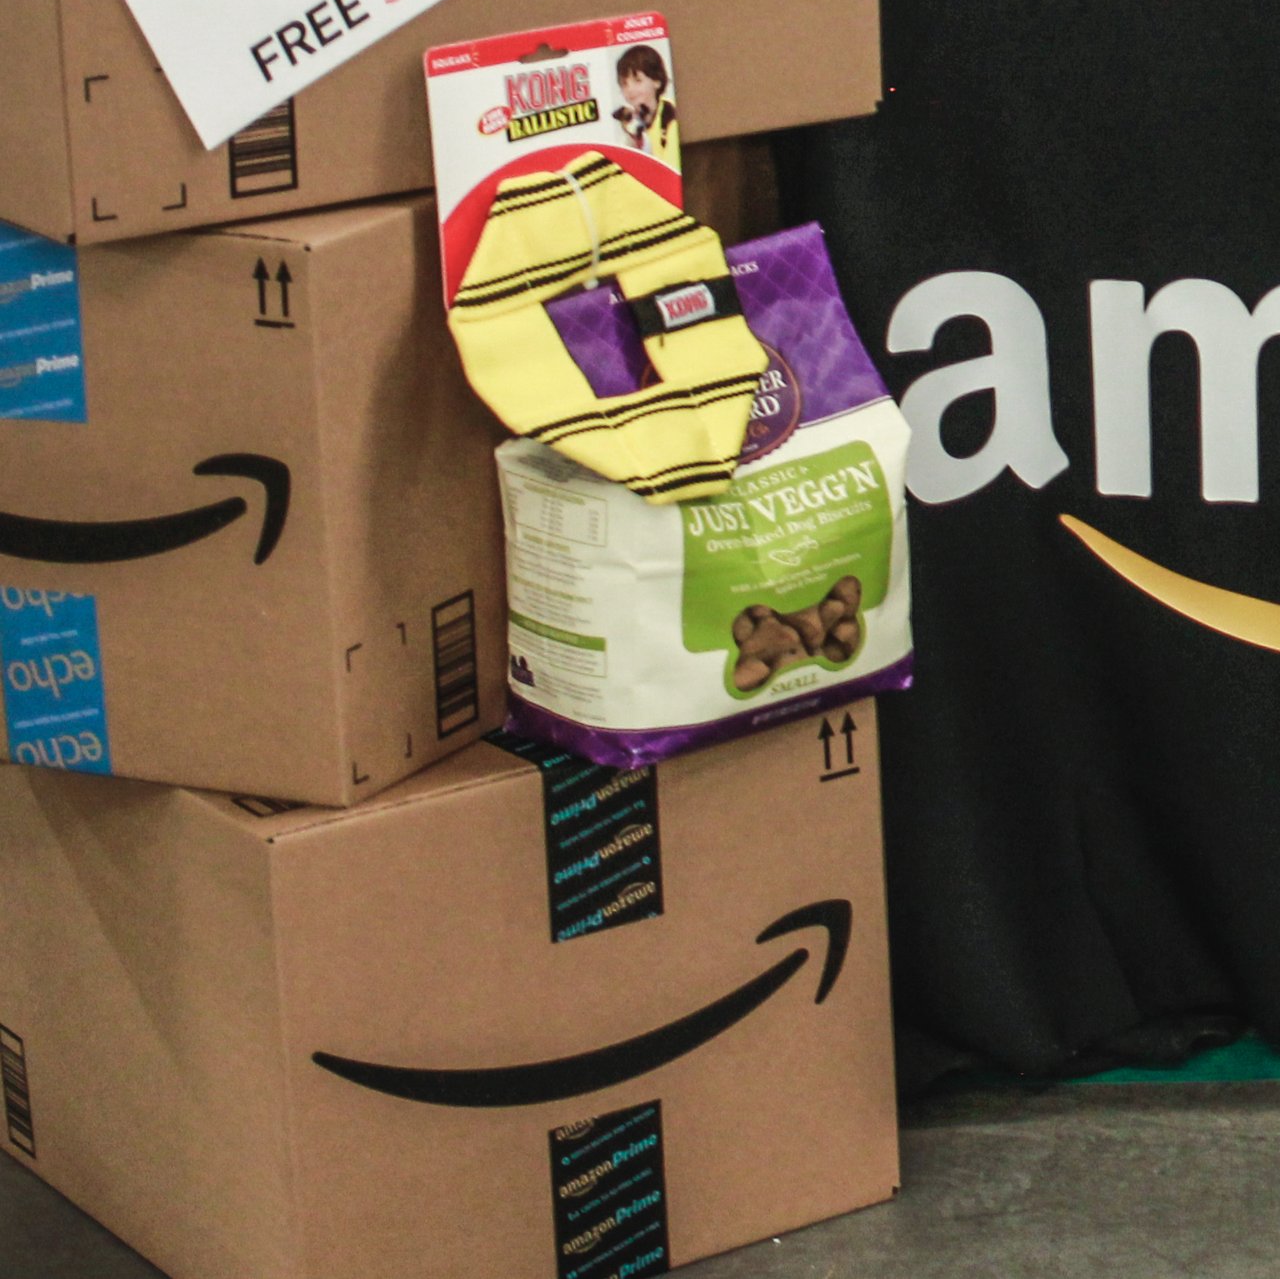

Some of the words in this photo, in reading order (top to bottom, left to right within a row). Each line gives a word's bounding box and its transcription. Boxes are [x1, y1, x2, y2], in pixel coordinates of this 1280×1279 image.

[505, 63, 591, 115] KONG
[509, 100, 598, 141] BALLISTIC
[665, 292, 709, 319] KONG
[689, 502, 751, 536] JUST
[748, 460, 880, 522] VEGG'N
[8, 649, 96, 698] echo
